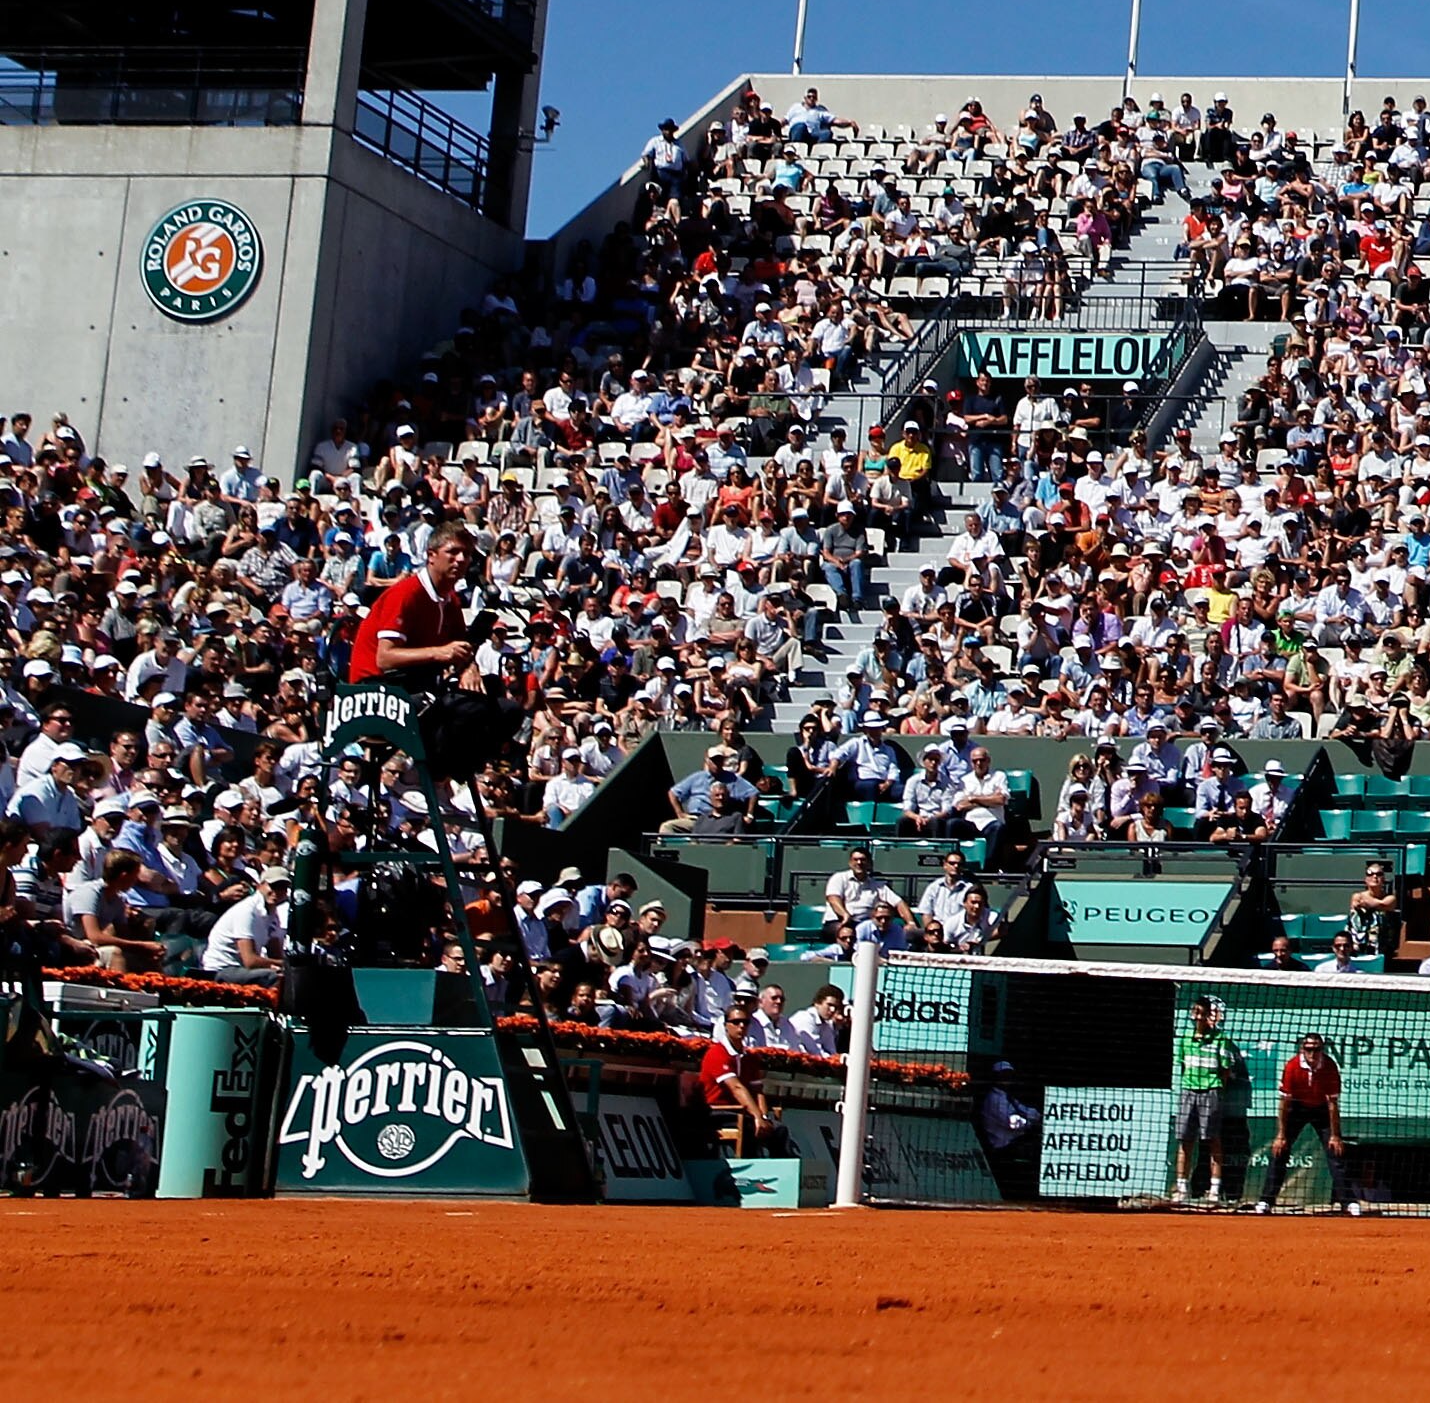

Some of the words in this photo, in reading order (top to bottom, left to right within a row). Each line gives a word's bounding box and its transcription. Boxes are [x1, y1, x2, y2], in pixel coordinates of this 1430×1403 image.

[147, 206, 203, 272] ROLAND
[208, 207, 254, 272] GARROS
[160, 286, 233, 311] PARIS
[982, 337, 1168, 376] AFFLELOU
[874, 993, 960, 1025] didas
[203, 1026, 260, 1198] FedEx
[1045, 1104, 1134, 1122] AFFLELOU
[1044, 1134, 1132, 1152] AFFLELOU
[1042, 1164, 1130, 1181] AFFLELOU
